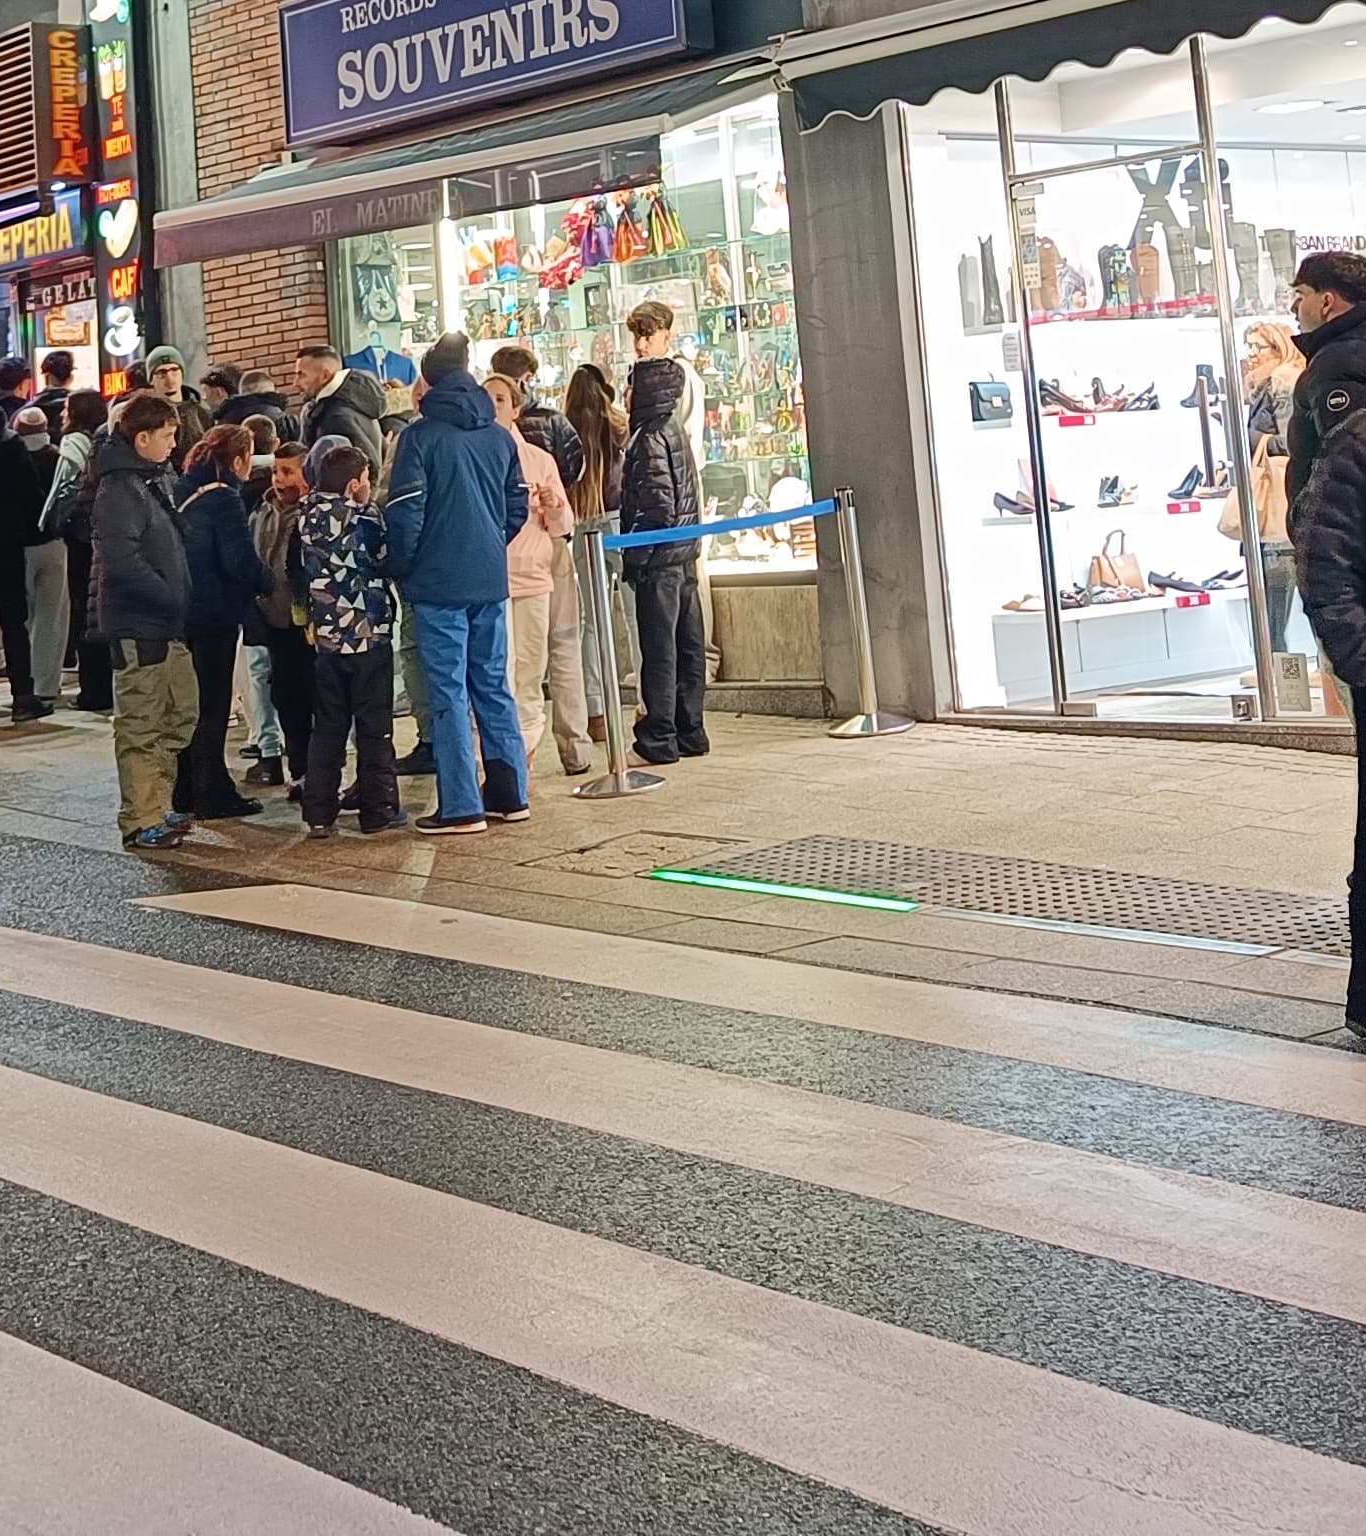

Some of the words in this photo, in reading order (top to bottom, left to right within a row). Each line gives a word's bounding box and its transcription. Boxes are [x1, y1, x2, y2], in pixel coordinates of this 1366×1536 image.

[47, 30, 84, 176] CREPERIA
[311, 207, 338, 236] EL
[1019, 205, 1036, 218] VISA
[1292, 235, 1325, 251] RBAN
[1327, 235, 1366, 251] BRAND
[112, 259, 139, 298] CAF
